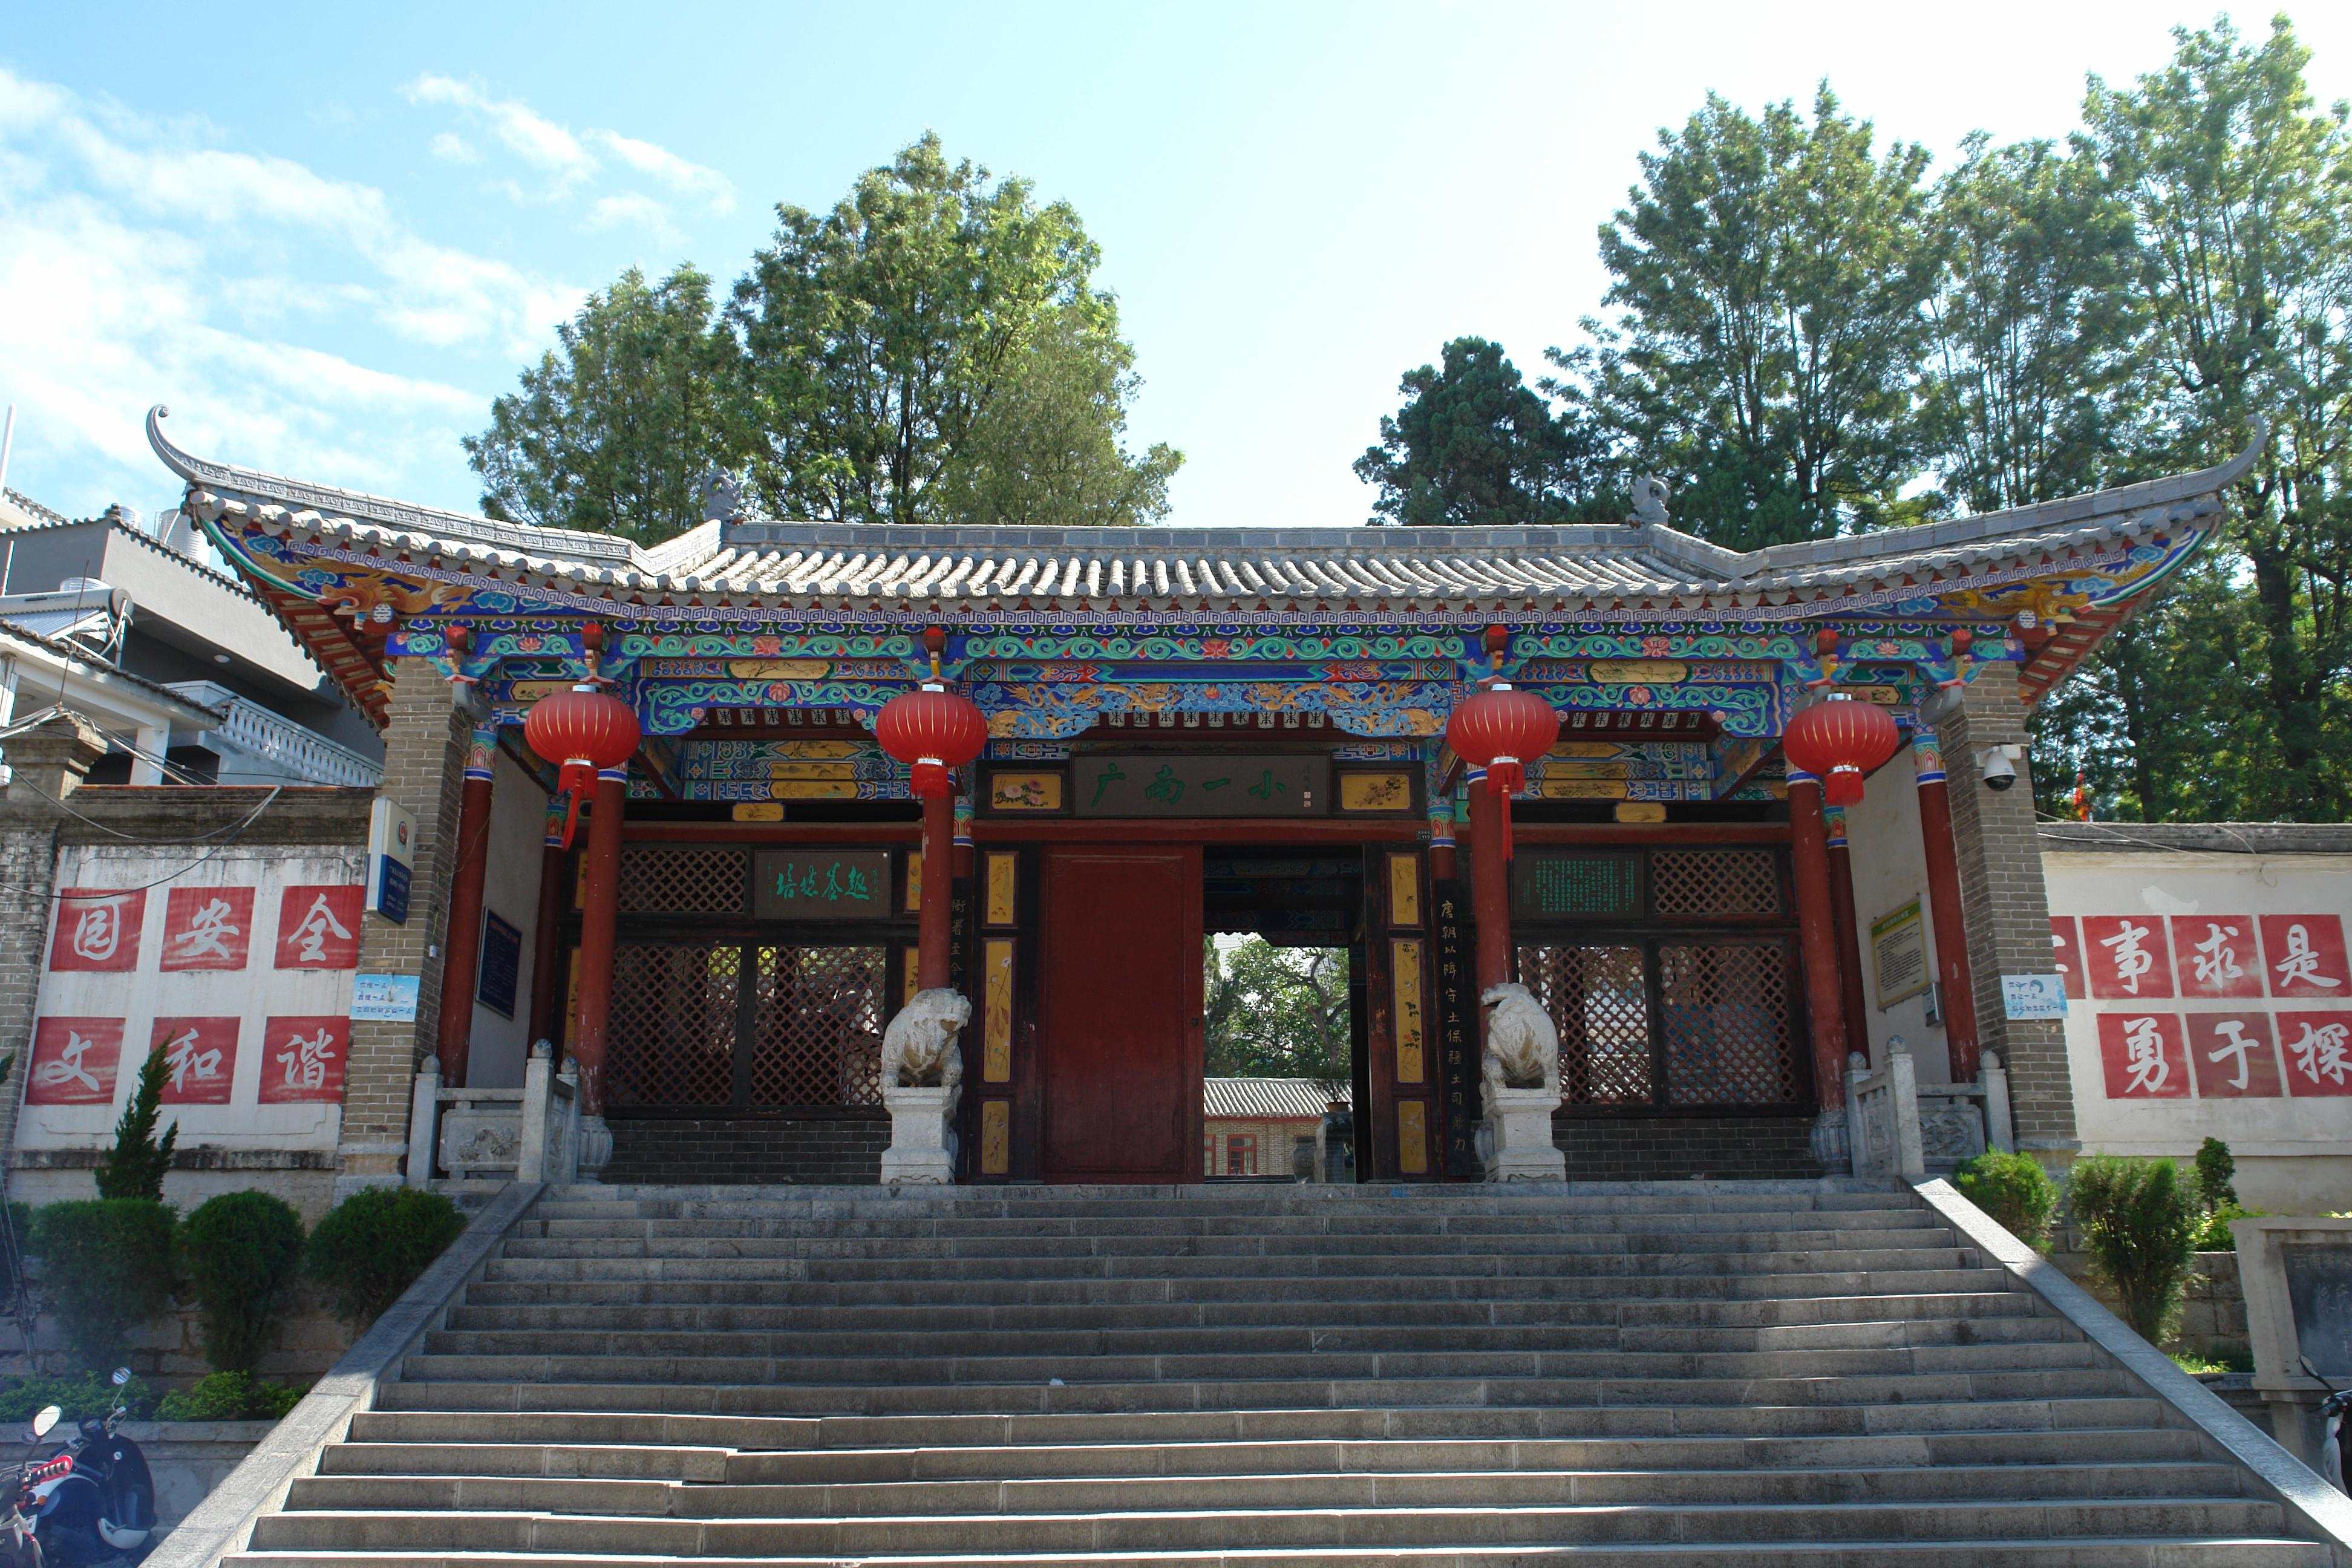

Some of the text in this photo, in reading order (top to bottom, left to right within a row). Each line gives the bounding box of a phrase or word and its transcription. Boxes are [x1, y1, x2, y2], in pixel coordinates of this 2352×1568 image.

[1091, 762, 1287, 808] 广南一小
[74, 892, 353, 962] 园安全
[44, 1027, 336, 1094] 文和谐
[2123, 1016, 2352, 1093] 勇于探
